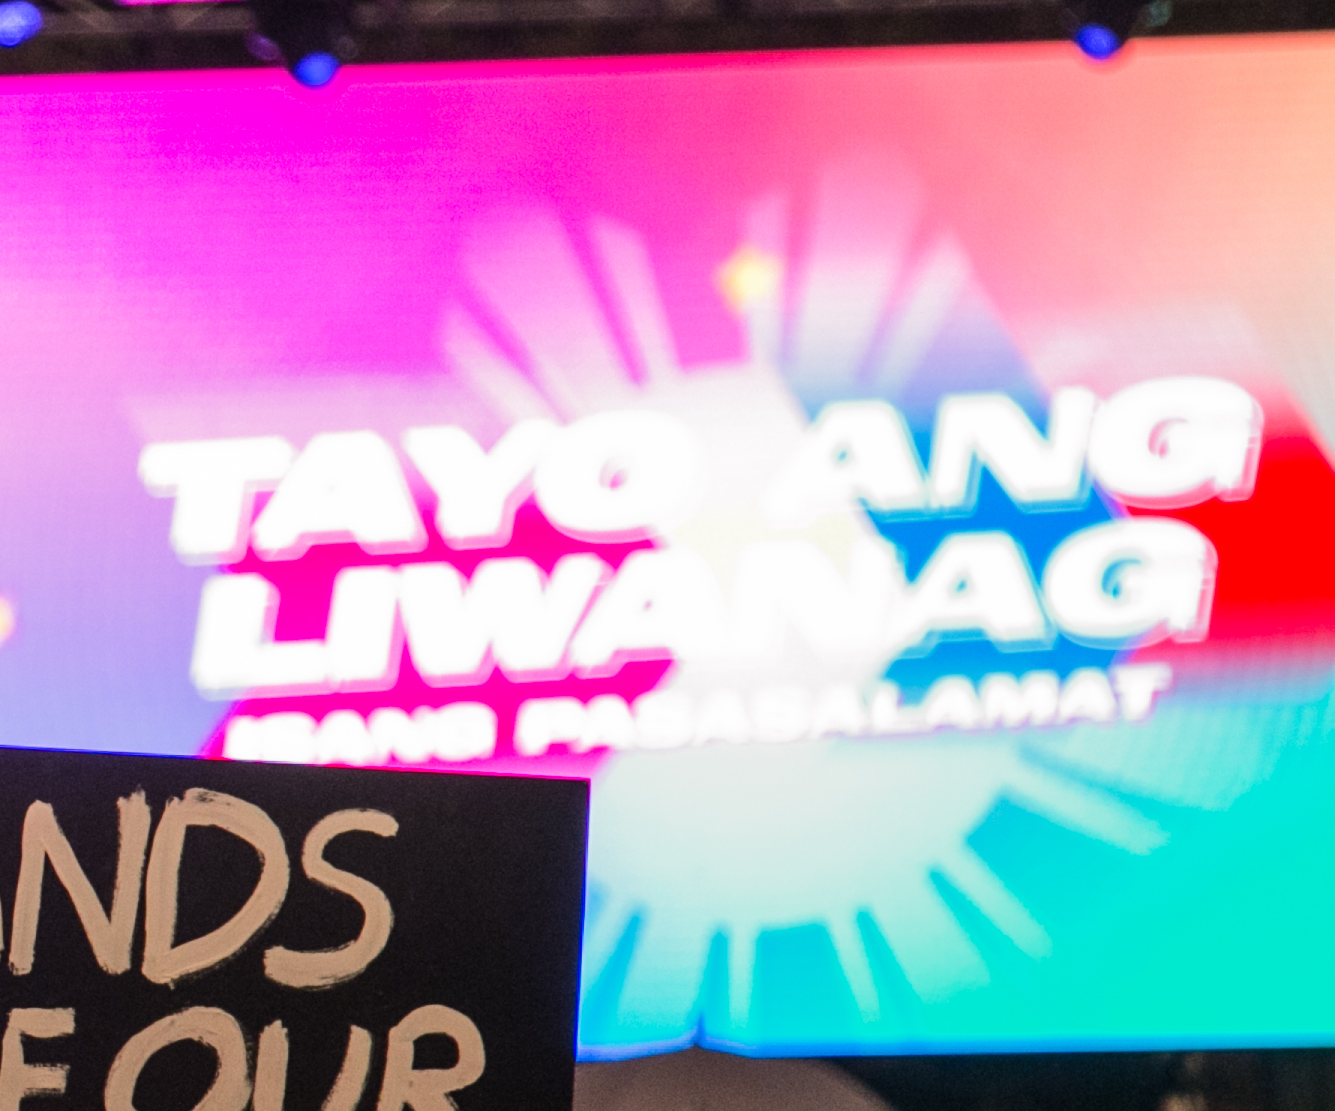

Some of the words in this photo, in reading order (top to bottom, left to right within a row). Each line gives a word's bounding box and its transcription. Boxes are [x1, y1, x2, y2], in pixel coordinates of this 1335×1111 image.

[137, 405, 699, 563] TAYO
[771, 376, 1263, 517] ANG
[191, 517, 1219, 698] LIWANAG
